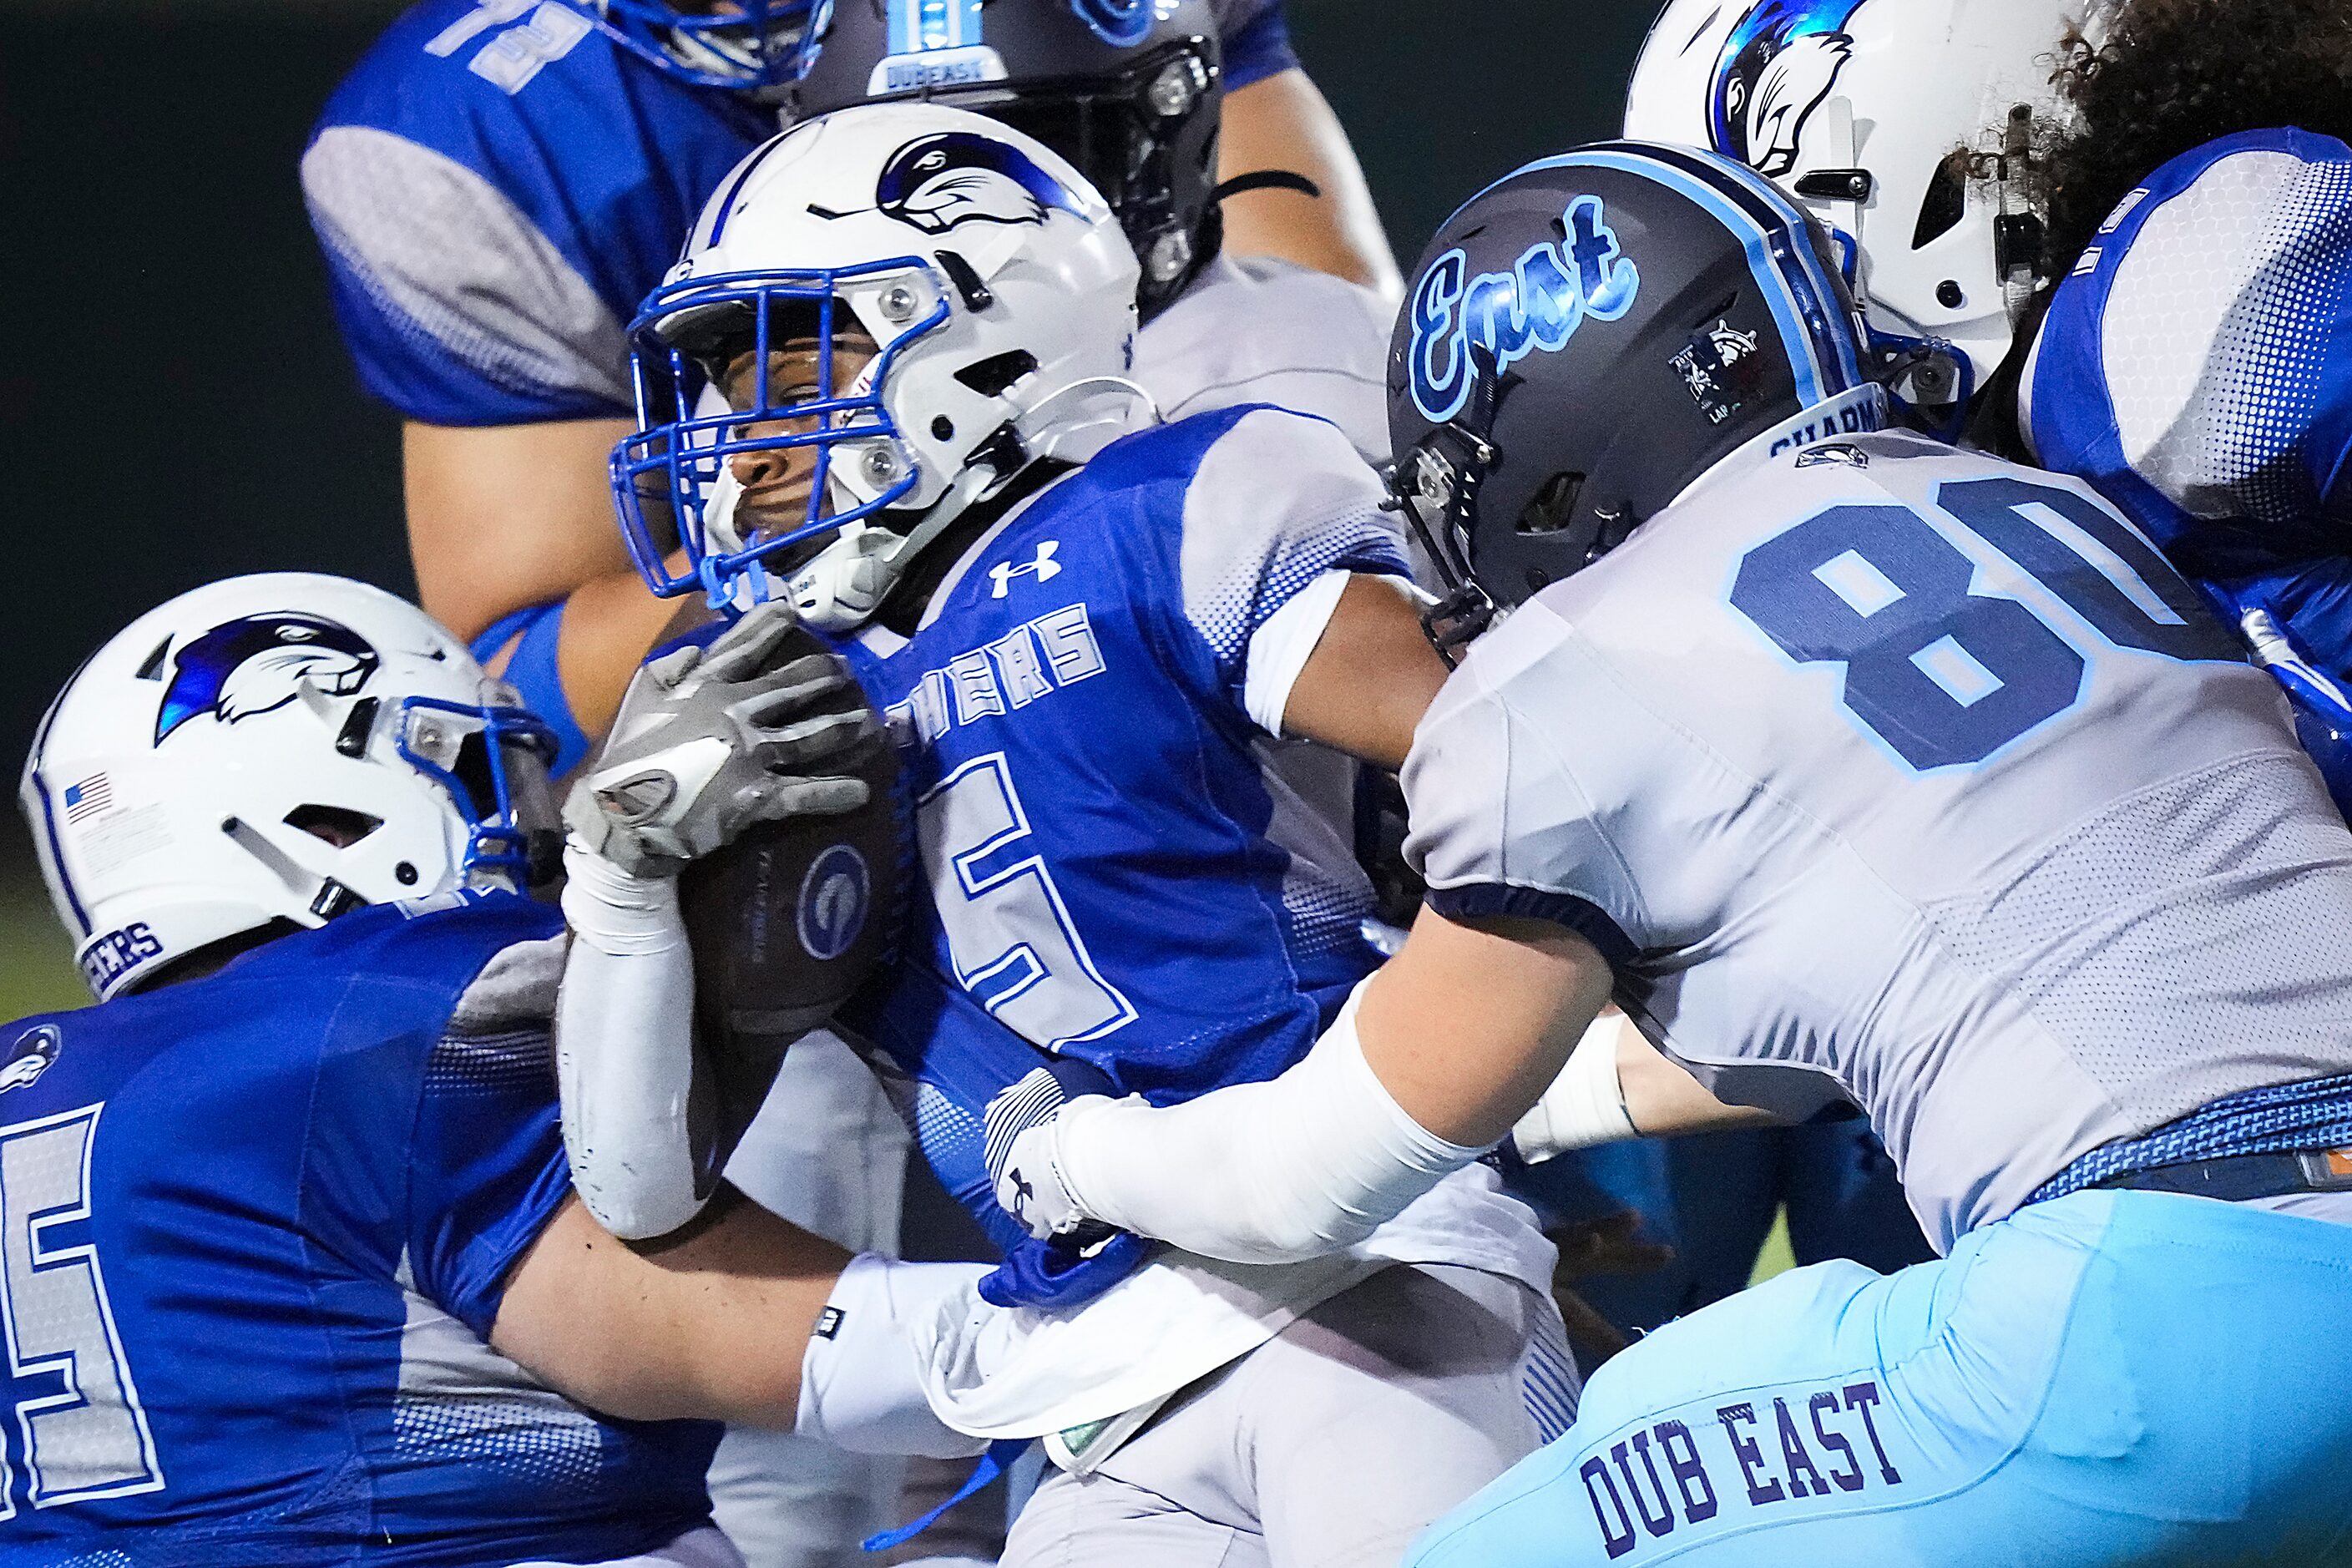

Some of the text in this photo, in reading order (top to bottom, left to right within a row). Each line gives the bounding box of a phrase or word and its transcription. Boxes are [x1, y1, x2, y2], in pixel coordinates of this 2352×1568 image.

[1408, 194, 1640, 422] East
[1726, 476, 2252, 773] 80
[0, 1100, 165, 1521] 5
[1580, 1382, 1903, 1560] DUB EAST
